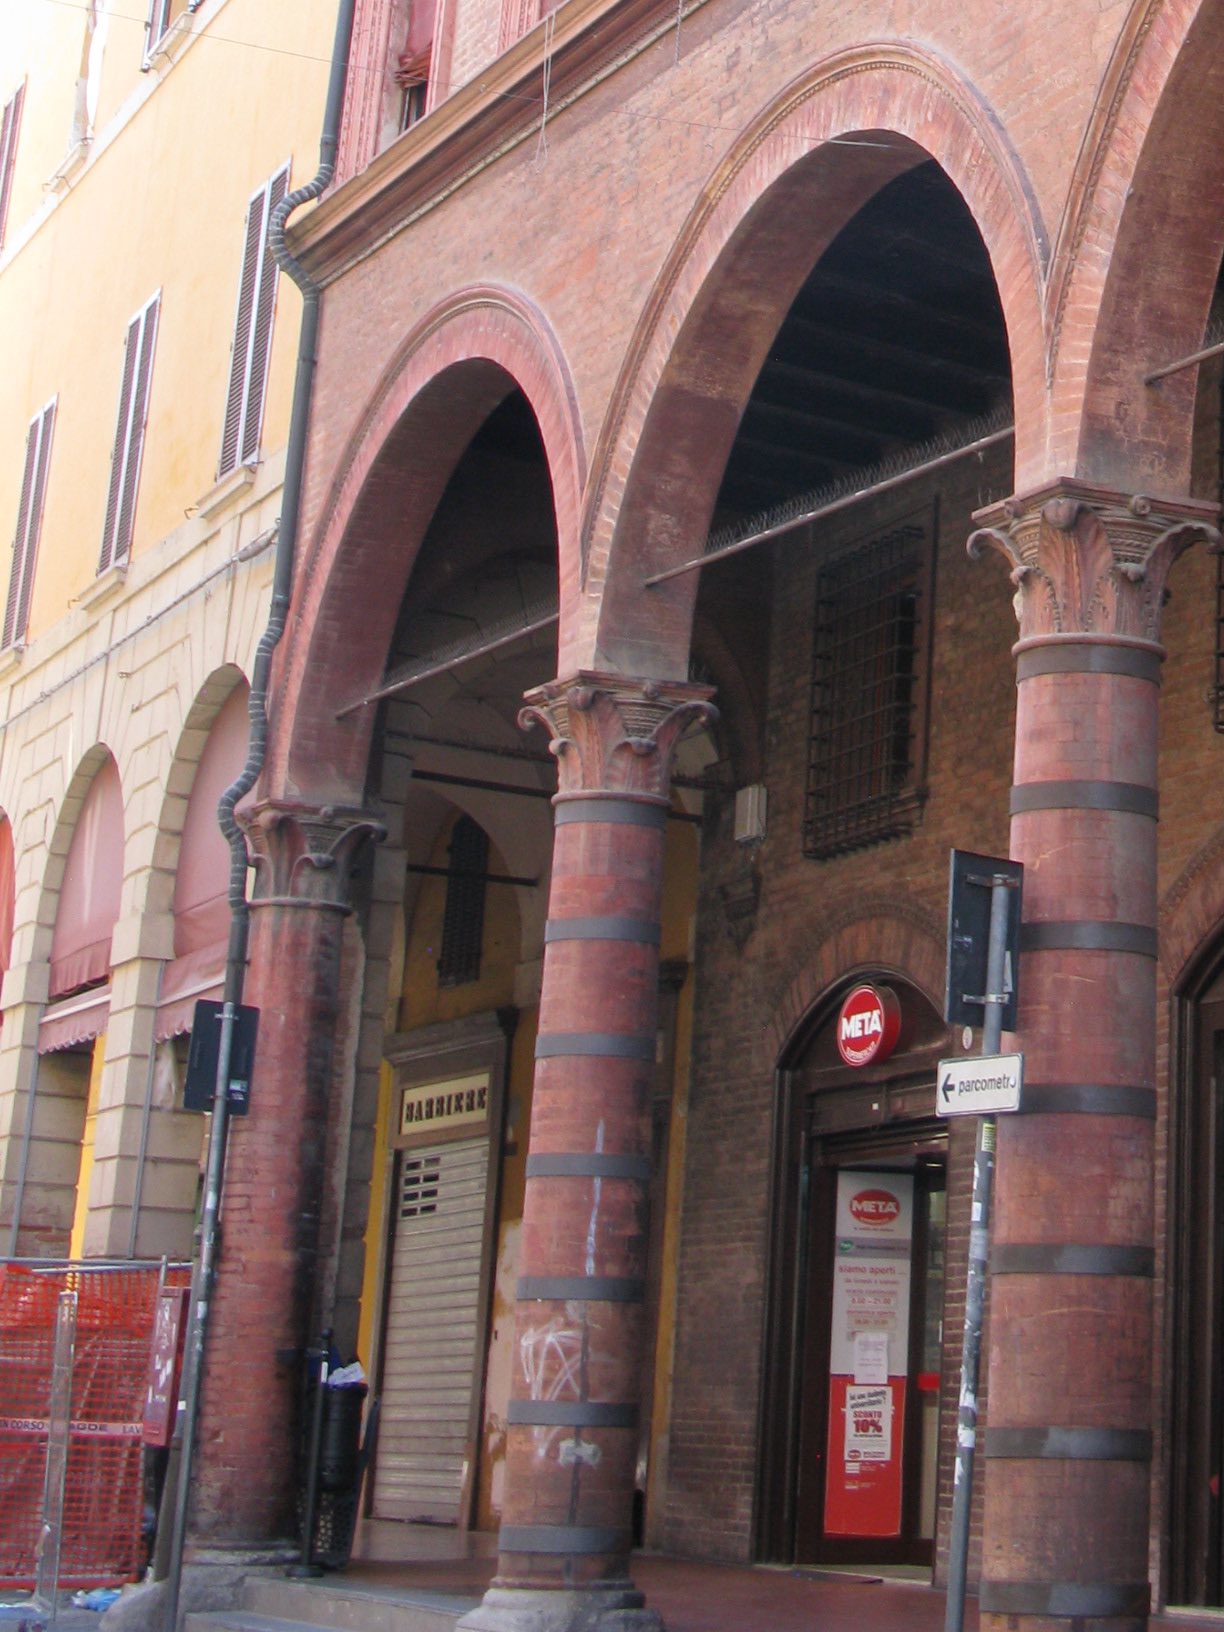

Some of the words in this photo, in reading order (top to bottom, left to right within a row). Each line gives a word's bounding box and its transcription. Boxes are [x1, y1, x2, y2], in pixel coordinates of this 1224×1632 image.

[405, 1086, 487, 1123] BARBIERE
[853, 1410, 883, 1419] SCONTO
[11, 1419, 45, 1431] CORSO
[853, 1419, 883, 1434] 10%
